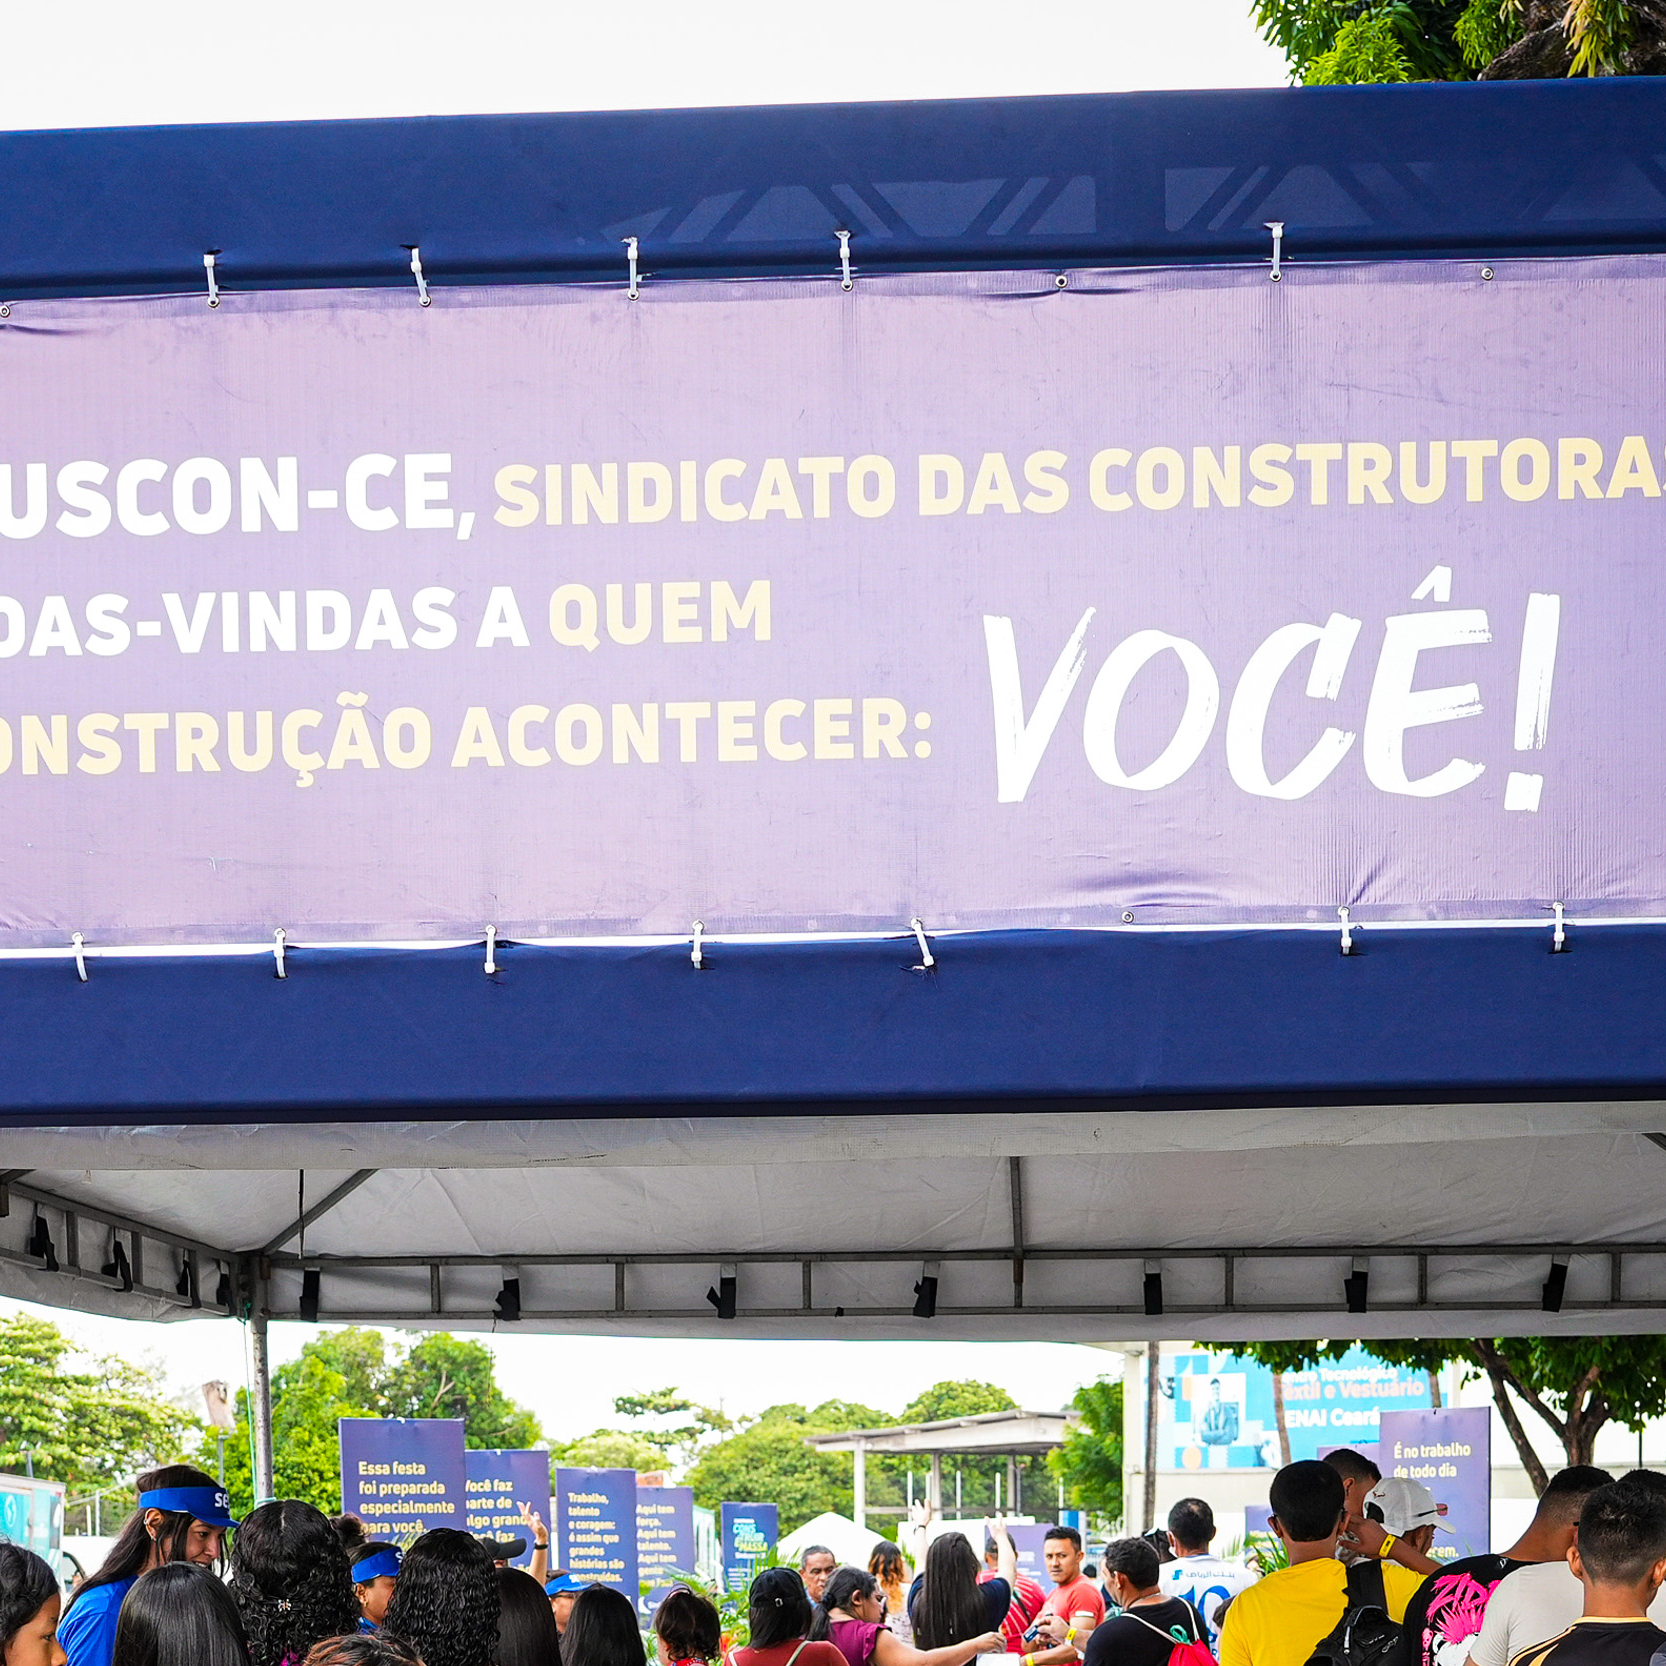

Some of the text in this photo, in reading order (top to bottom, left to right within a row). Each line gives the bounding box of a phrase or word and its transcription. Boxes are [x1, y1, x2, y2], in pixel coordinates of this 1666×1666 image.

[493, 454, 896, 528] SINDICATO
[918, 449, 1070, 519] DAS
[475, 586, 530, 648] A
[548, 580, 773, 652] QUEM
[983, 565, 1561, 812] VOCÊ!
[451, 698, 932, 770] ACONTECER:
[1319, 1366, 1398, 1384] Tecnológico
[1283, 1381, 1321, 1400] êxtil
[1339, 1377, 1425, 1398] Vestuário
[1284, 1406, 1380, 1428] ENAI Ceará
[1394, 1441, 1471, 1459] É no trabalho
[358, 1460, 426, 1475] Essa festa
[1394, 1462, 1457, 1479] de todo dia
[359, 1480, 446, 1497] foi preparada
[494, 1479, 513, 1492] faz
[215, 1492, 229, 1508] SE
[360, 1500, 455, 1516] especialmente
[496, 1496, 512, 1509] de
[393, 1519, 428, 1533] você.
[492, 1515, 528, 1529] gran
